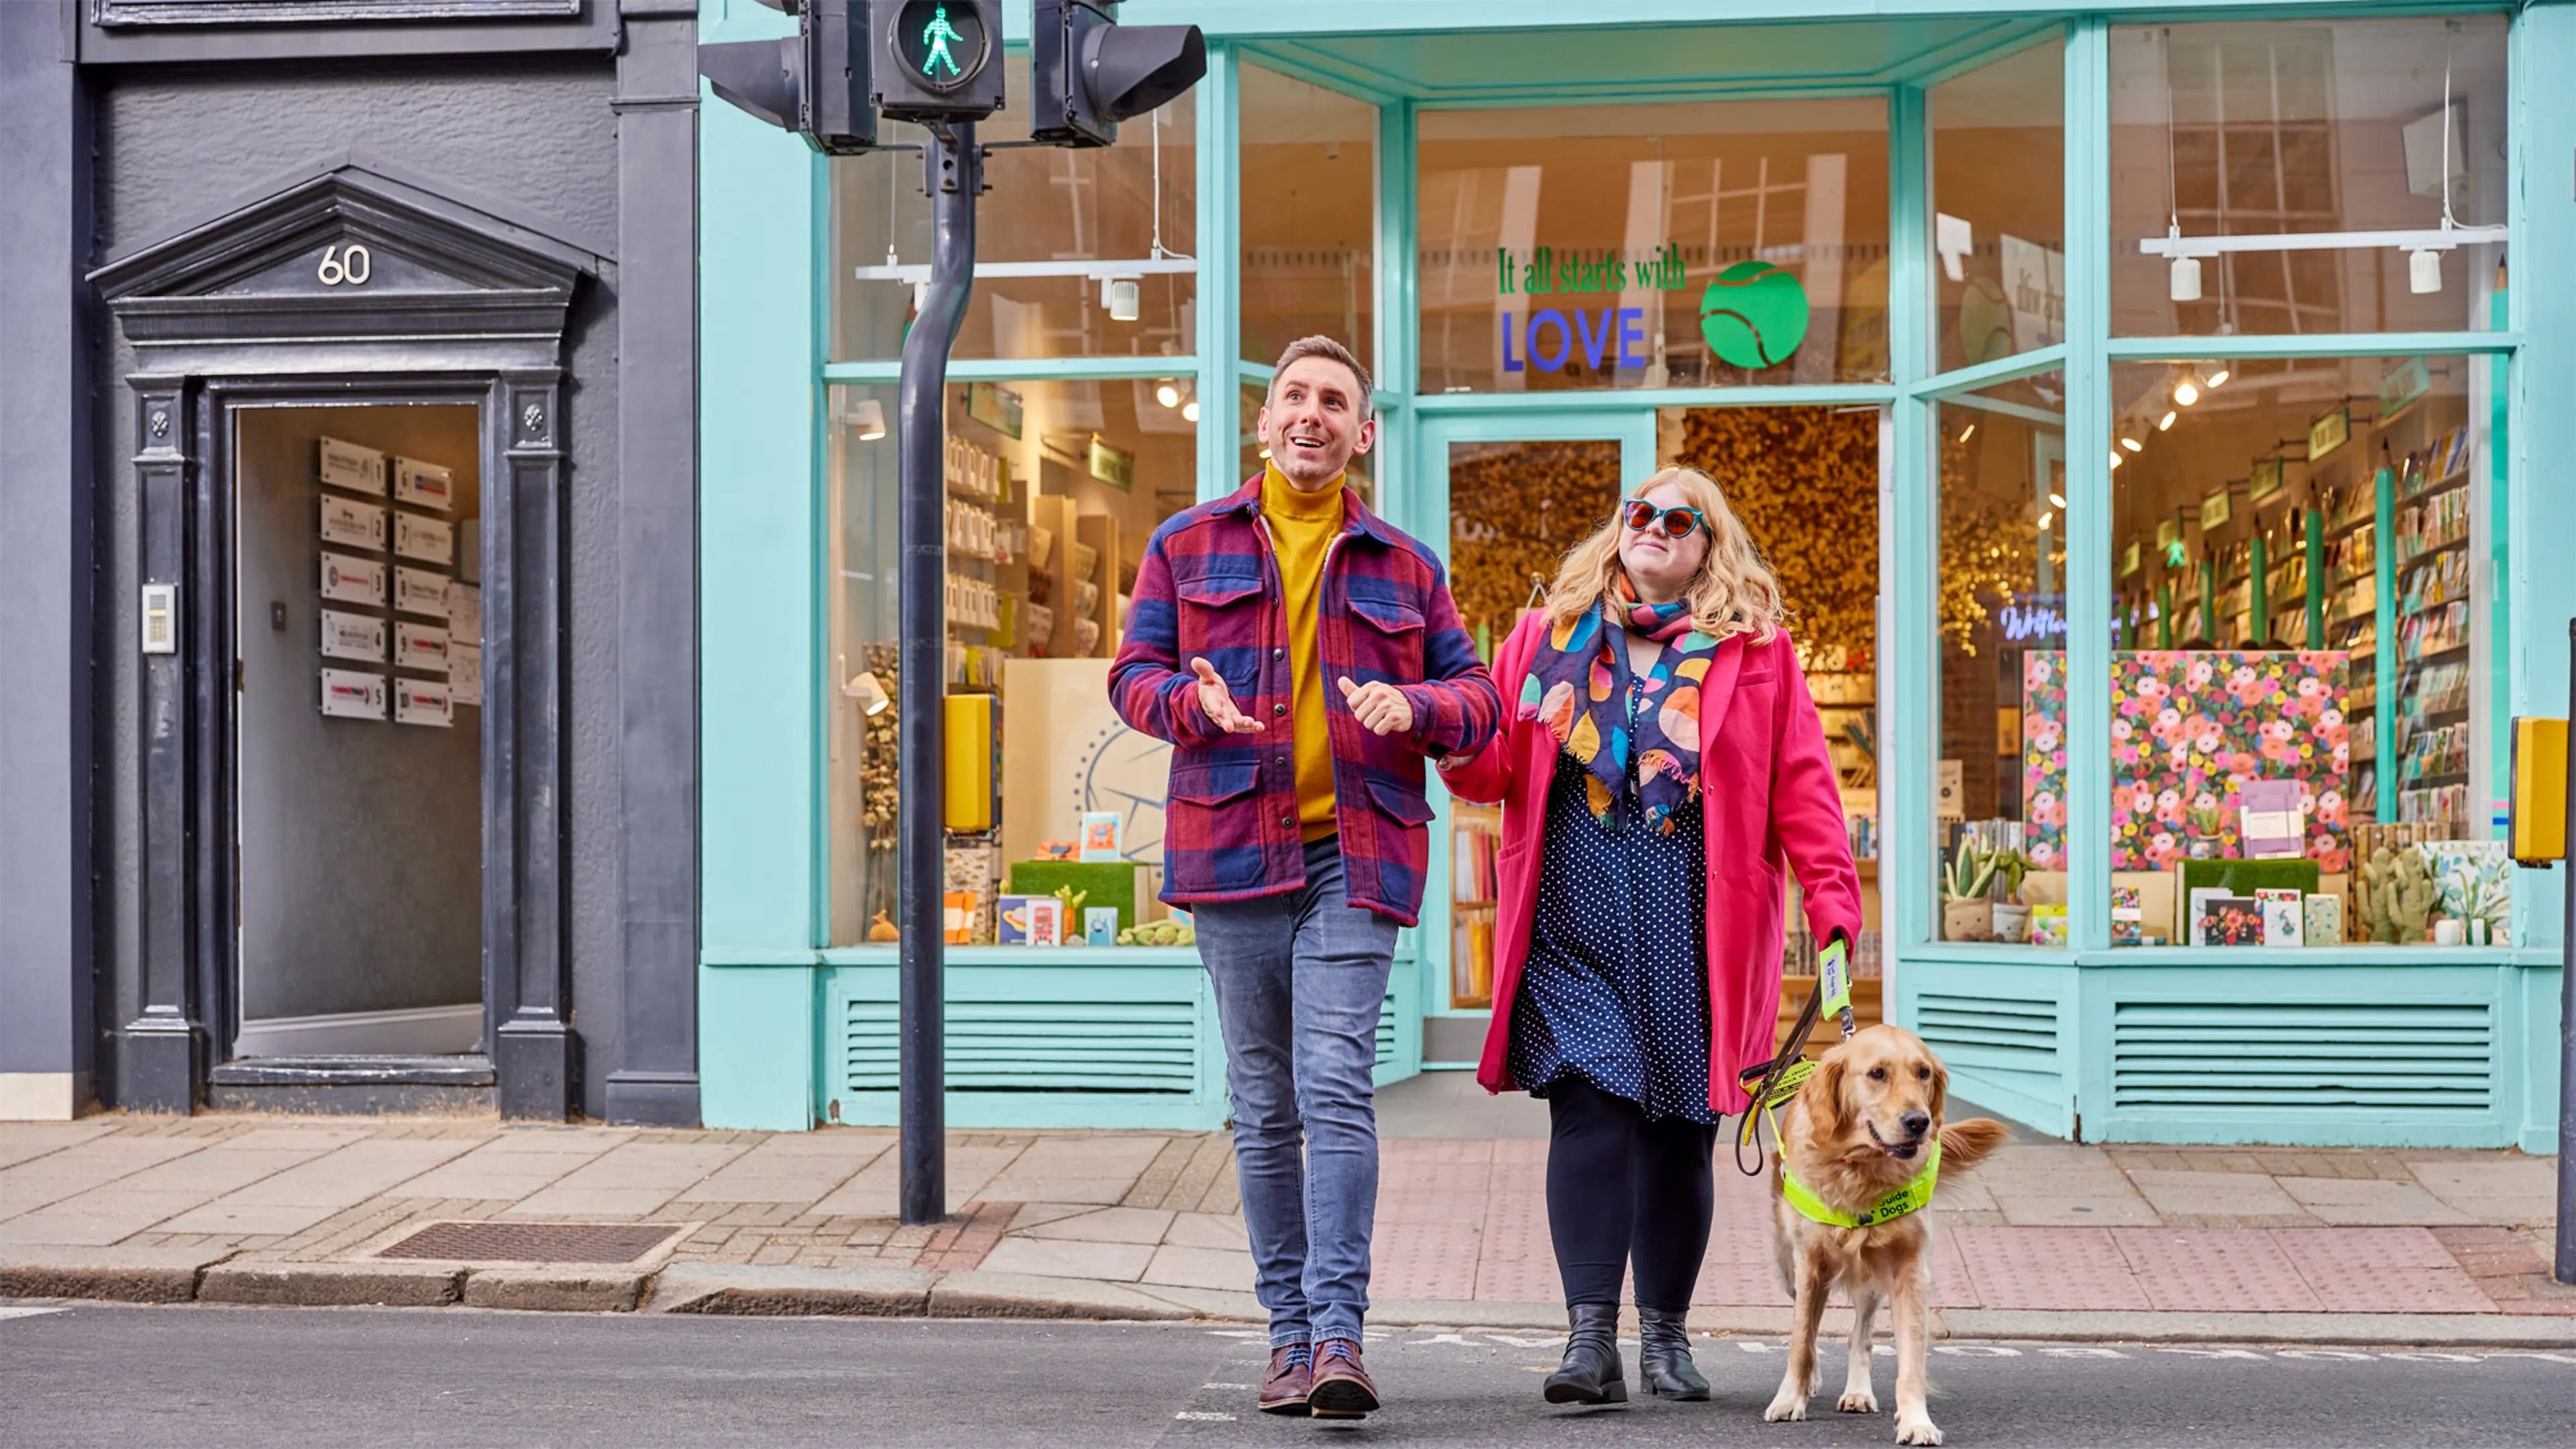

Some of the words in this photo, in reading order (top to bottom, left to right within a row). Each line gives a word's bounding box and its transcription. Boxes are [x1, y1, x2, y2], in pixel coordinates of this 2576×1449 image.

[318, 244, 370, 285] 60
[1498, 248, 1515, 294] It
[1523, 246, 1551, 294] all
[1560, 252, 1627, 293] starts
[1635, 242, 1686, 290] with
[1503, 307, 1645, 372] LOVE
[376, 519, 382, 537] 2
[401, 524, 407, 541] 7
[376, 574, 381, 592] 3
[376, 688, 382, 704] 5
[1880, 1201, 1909, 1218] Dogs
